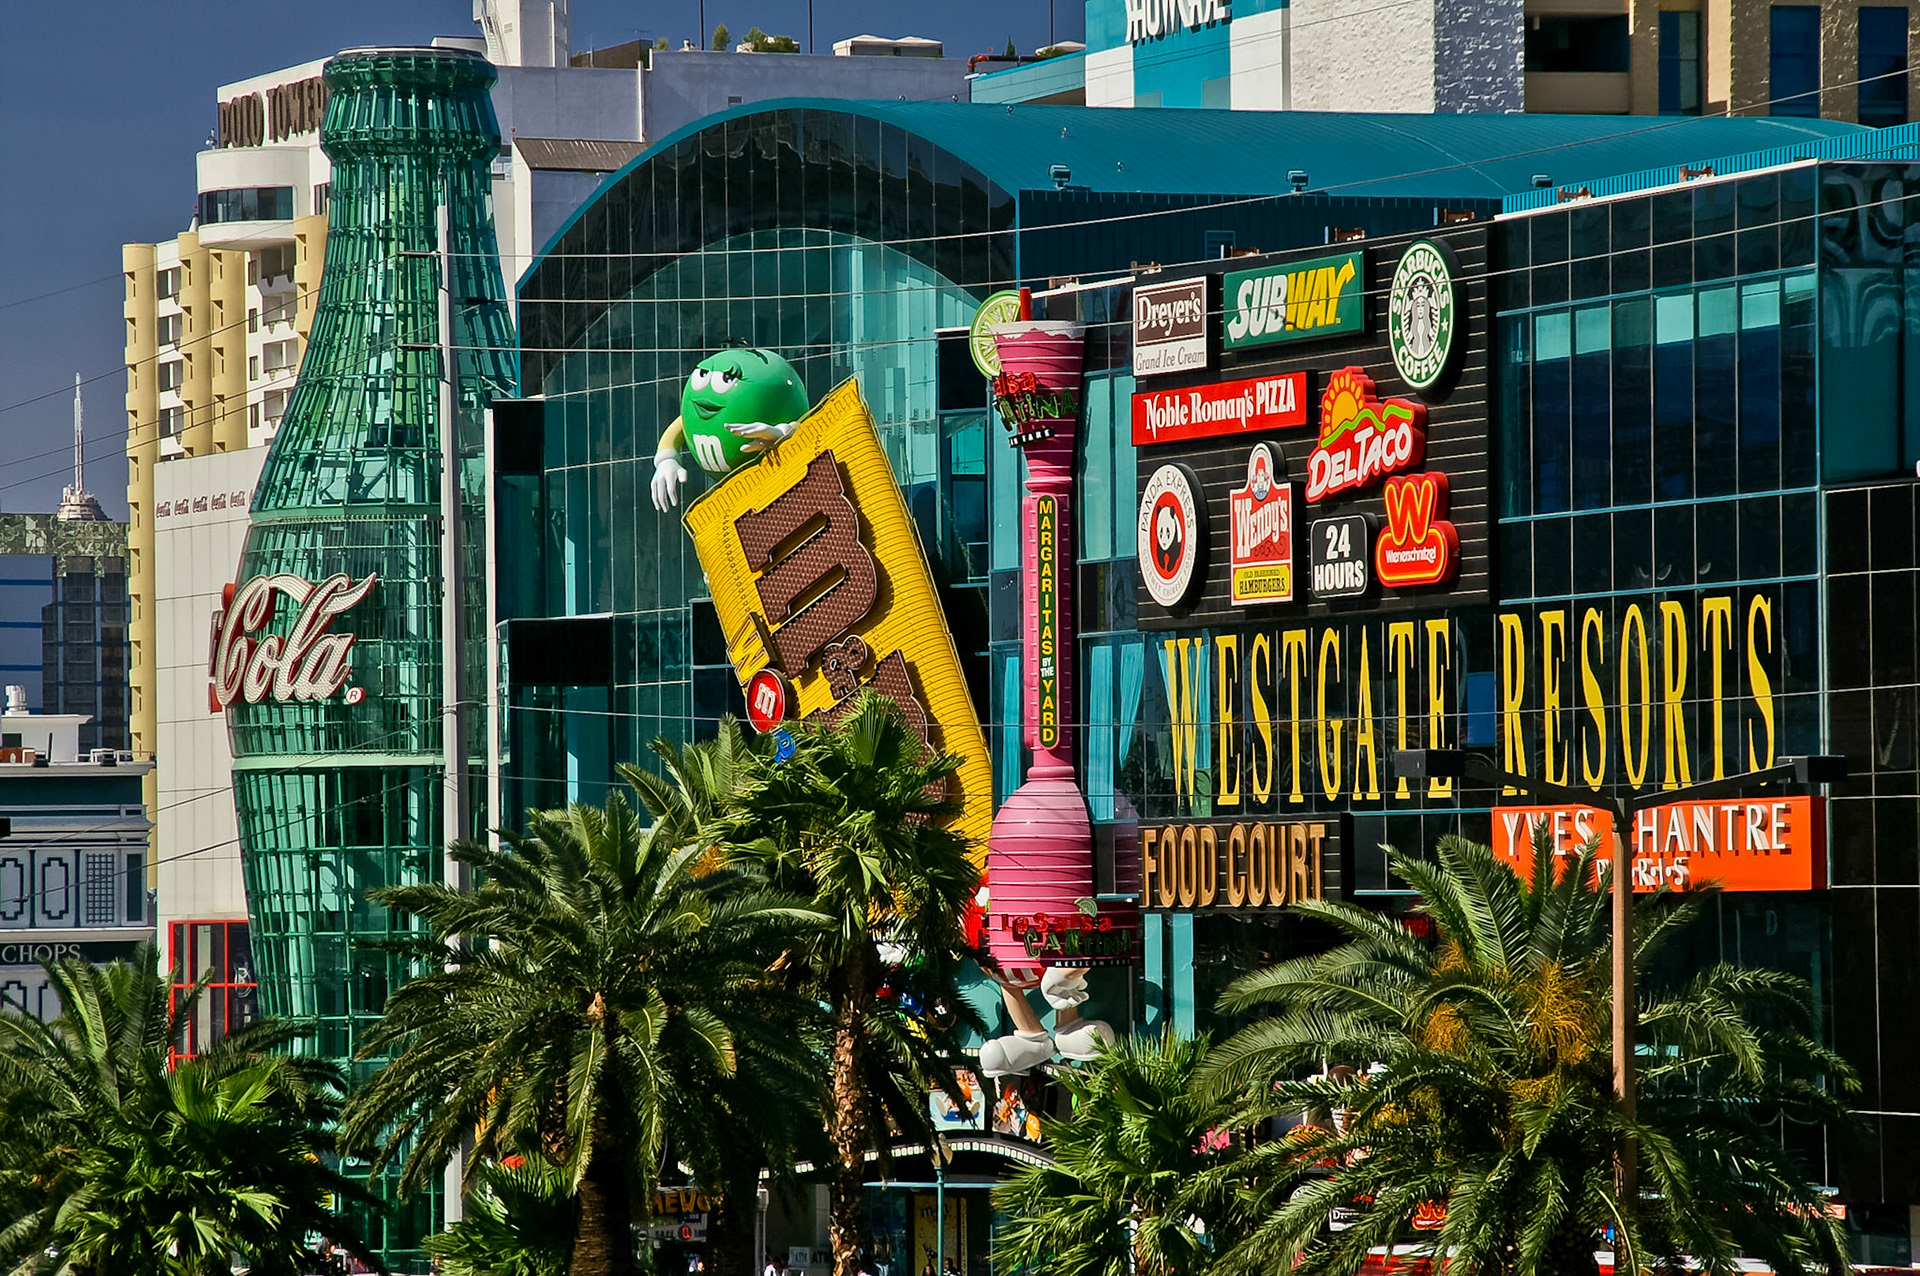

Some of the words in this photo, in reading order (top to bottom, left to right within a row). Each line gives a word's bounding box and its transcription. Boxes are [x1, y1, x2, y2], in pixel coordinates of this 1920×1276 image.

[218, 91, 263, 148] POLO
[1227, 257, 1356, 343] SUBWAY
[1392, 250, 1450, 315] STARBUCKS
[1137, 290, 1201, 337] Dreyer's
[1135, 350, 1161, 371] Grand
[1162, 348, 1176, 367] Ice
[1177, 346, 1205, 366] Cream
[1399, 340, 1444, 380] COFFEE
[1144, 394, 1189, 440] Noble
[1188, 387, 1254, 428] Roman's
[1255, 377, 1296, 416] PIZZA
[1354, 422, 1412, 482] TACO
[1140, 476, 1165, 533] PANDA
[1166, 471, 1195, 530] EXPRESS
[1234, 496, 1289, 559] Wendy's
[1384, 479, 1434, 546] W
[1325, 523, 1351, 560] 24
[1385, 546, 1437, 564] Wienerschnitzel
[1039, 500, 1054, 655] MARGARITAS
[1239, 577, 1285, 595] HAMBURGERS
[1314, 559, 1365, 592] HOURS
[215, 572, 377, 706] Cola
[1042, 657, 1052, 667] BY
[1040, 667, 1055, 678] THE
[1163, 618, 1452, 807] WESTGATE
[1499, 593, 1775, 797] RESORTS
[1041, 679, 1055, 743] YARD
[1630, 802, 1790, 854] HANTRE
[1142, 822, 1220, 909] FOOD
[1226, 821, 1326, 907] COURT
[2, 944, 81, 963] CHOPS
[1023, 929, 1133, 959] CANTINA
